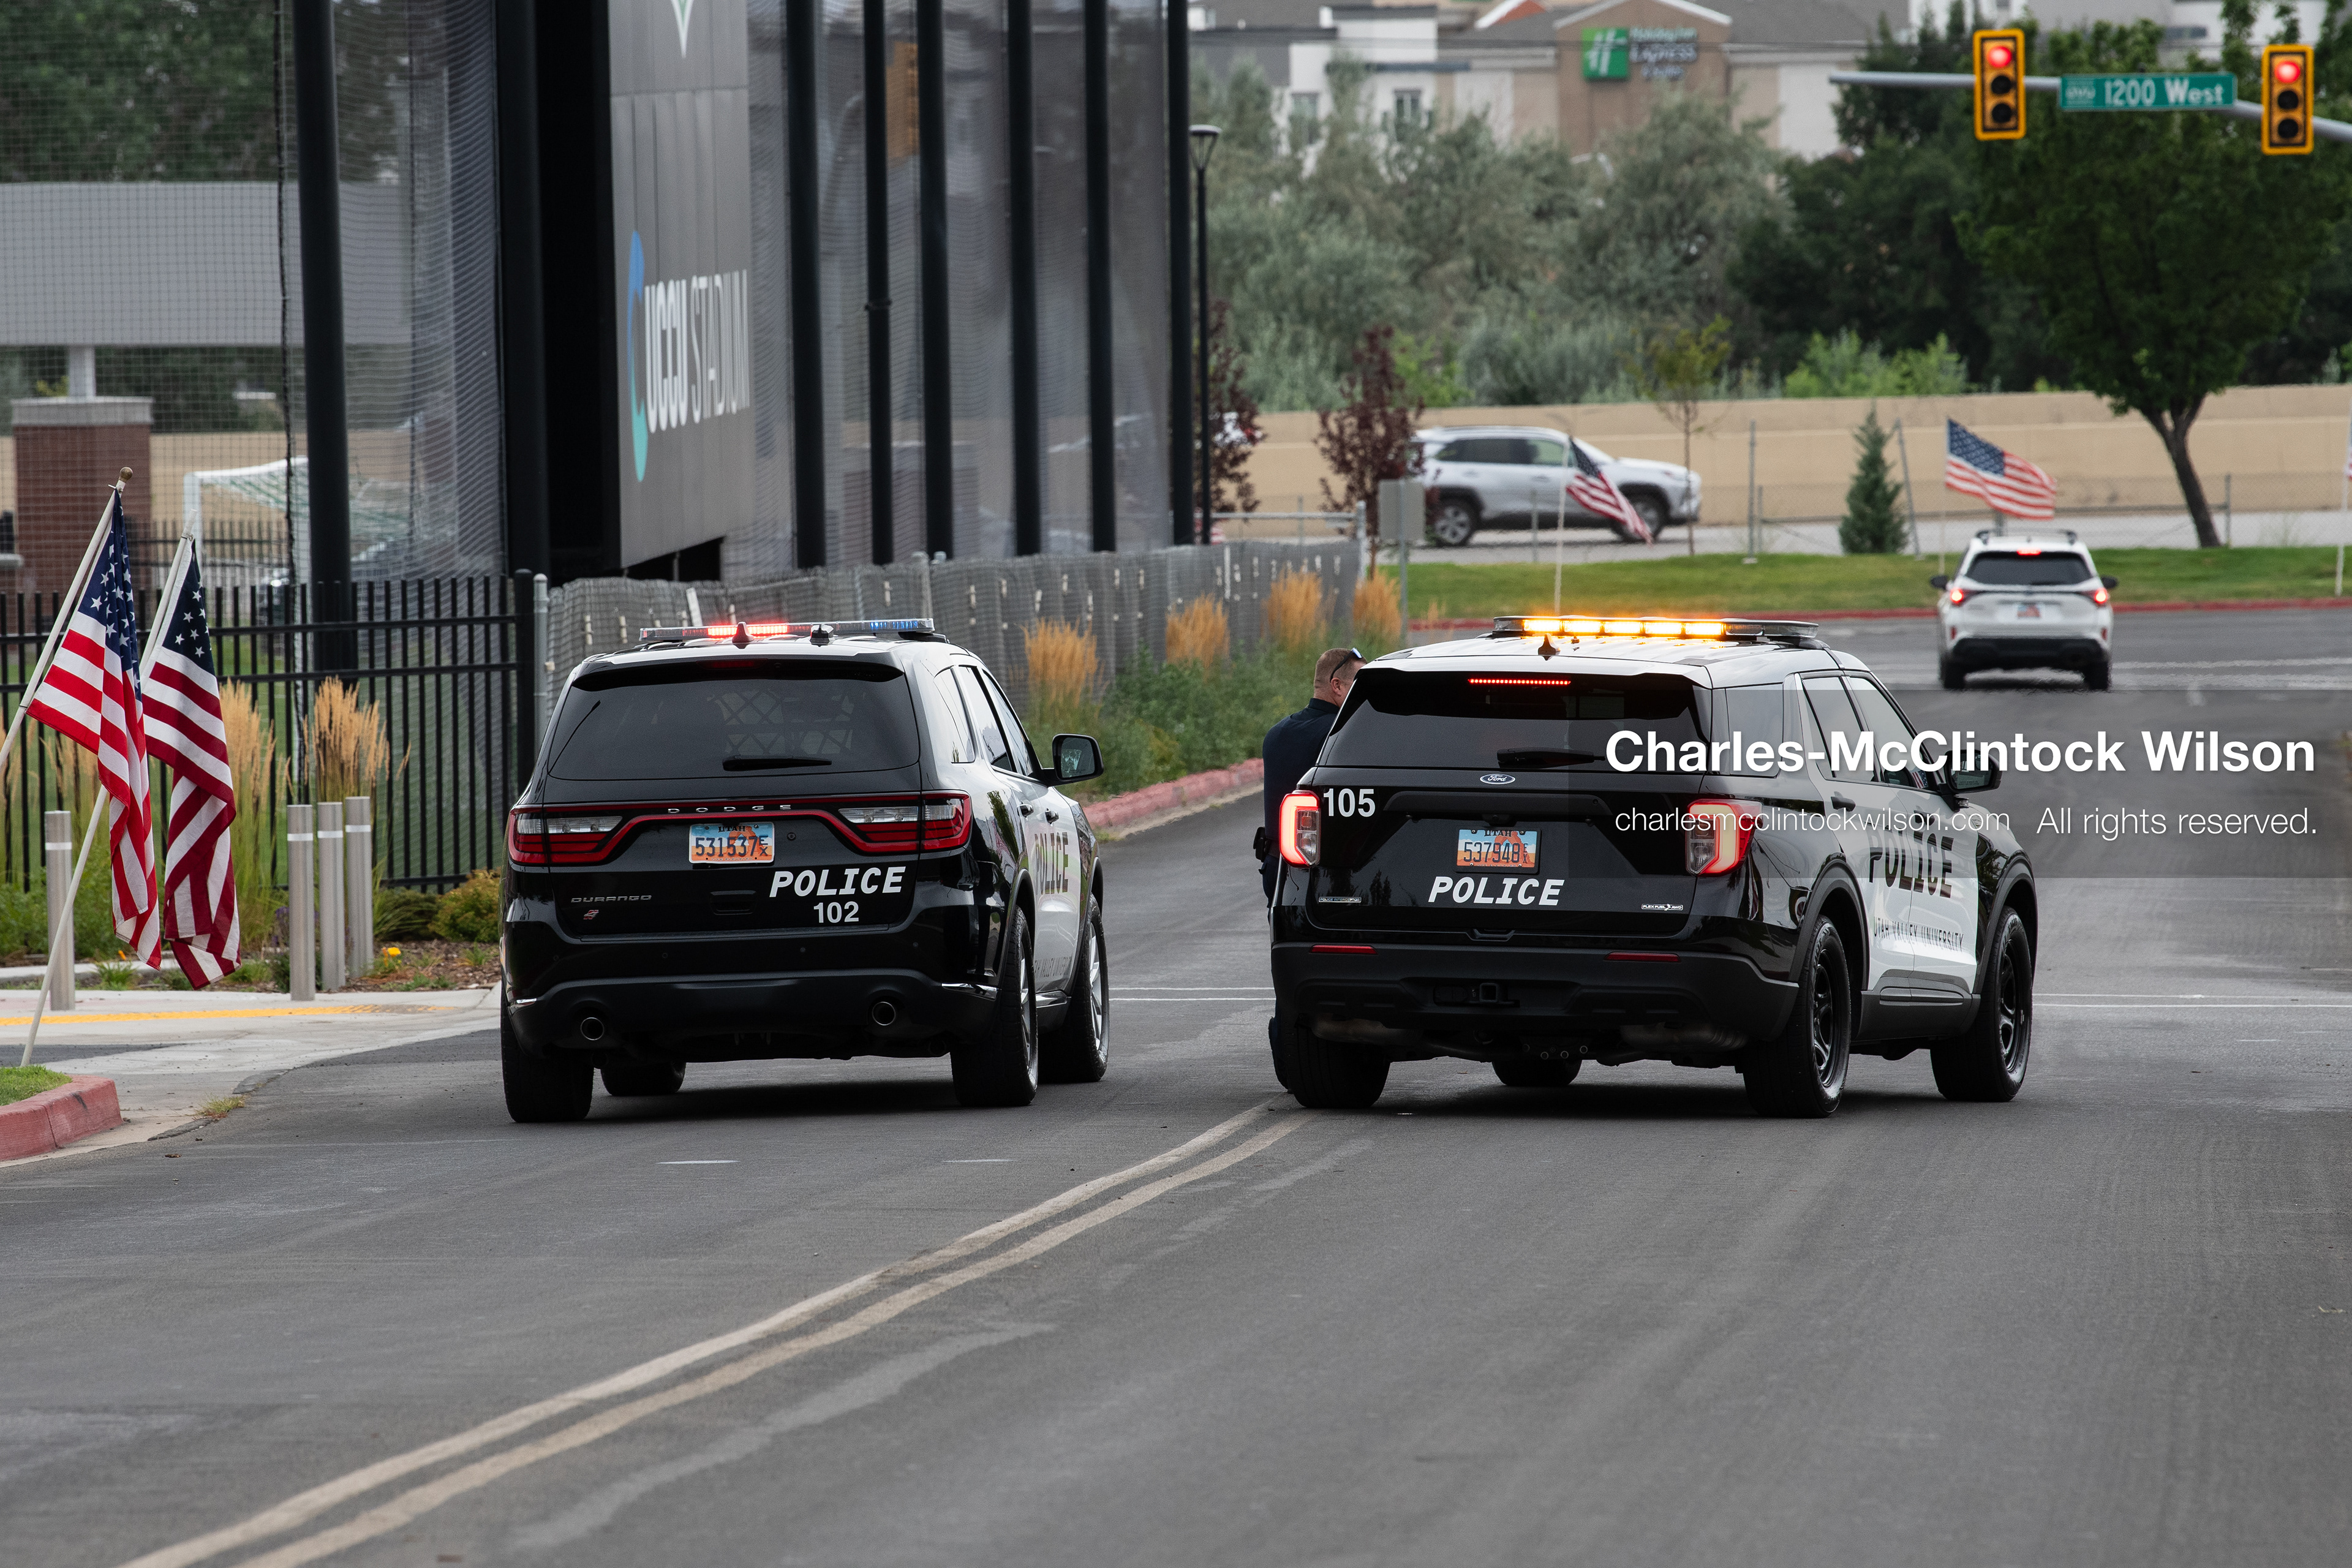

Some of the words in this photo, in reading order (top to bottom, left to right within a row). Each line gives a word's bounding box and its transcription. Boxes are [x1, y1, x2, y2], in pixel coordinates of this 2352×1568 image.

[2105, 78, 2155, 106] 1200
[2164, 78, 2223, 105] West
[645, 279, 688, 433] UCCU
[691, 269, 750, 423] STADIUM
[668, 804, 791, 813] DODGE
[1324, 788, 1376, 817] 105
[695, 837, 758, 857] 531537
[1463, 842, 1520, 863] 537948
[1865, 821, 1954, 899] POLICE
[1034, 832, 1069, 895] POLICE
[769, 866, 906, 898] POLICE
[1428, 876, 1565, 906] POLICE
[813, 901, 859, 923] 102
[1874, 916, 1890, 940] UTAH
[1892, 921, 1918, 945] VALLEY
[1921, 926, 1964, 952] UNIVERSITY
